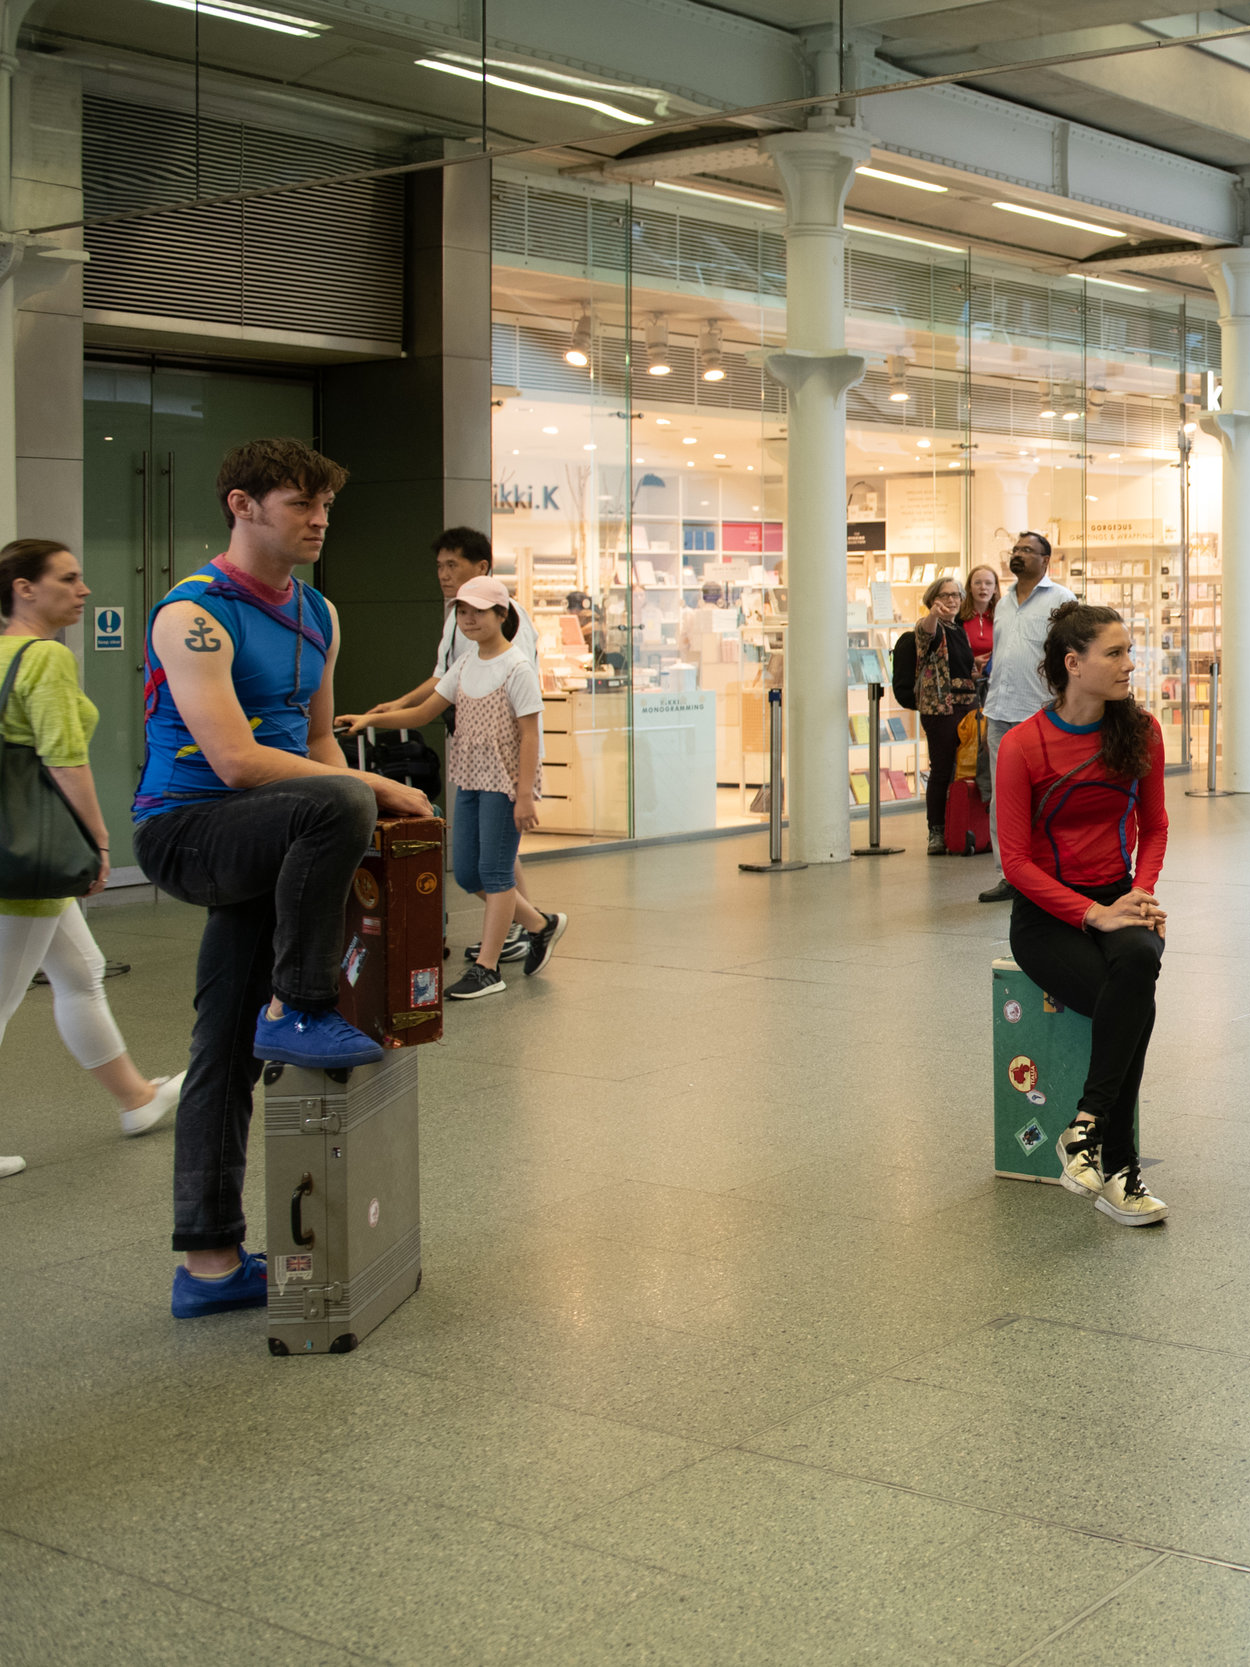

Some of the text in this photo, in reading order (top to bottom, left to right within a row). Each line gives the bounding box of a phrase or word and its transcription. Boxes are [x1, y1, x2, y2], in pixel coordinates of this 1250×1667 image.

[493, 482, 560, 511] ikki.K
[1090, 523, 1133, 532] GORGEOUS
[1069, 532, 1108, 542] GRETINGS
[641, 703, 705, 714] MONOGRAMMING
